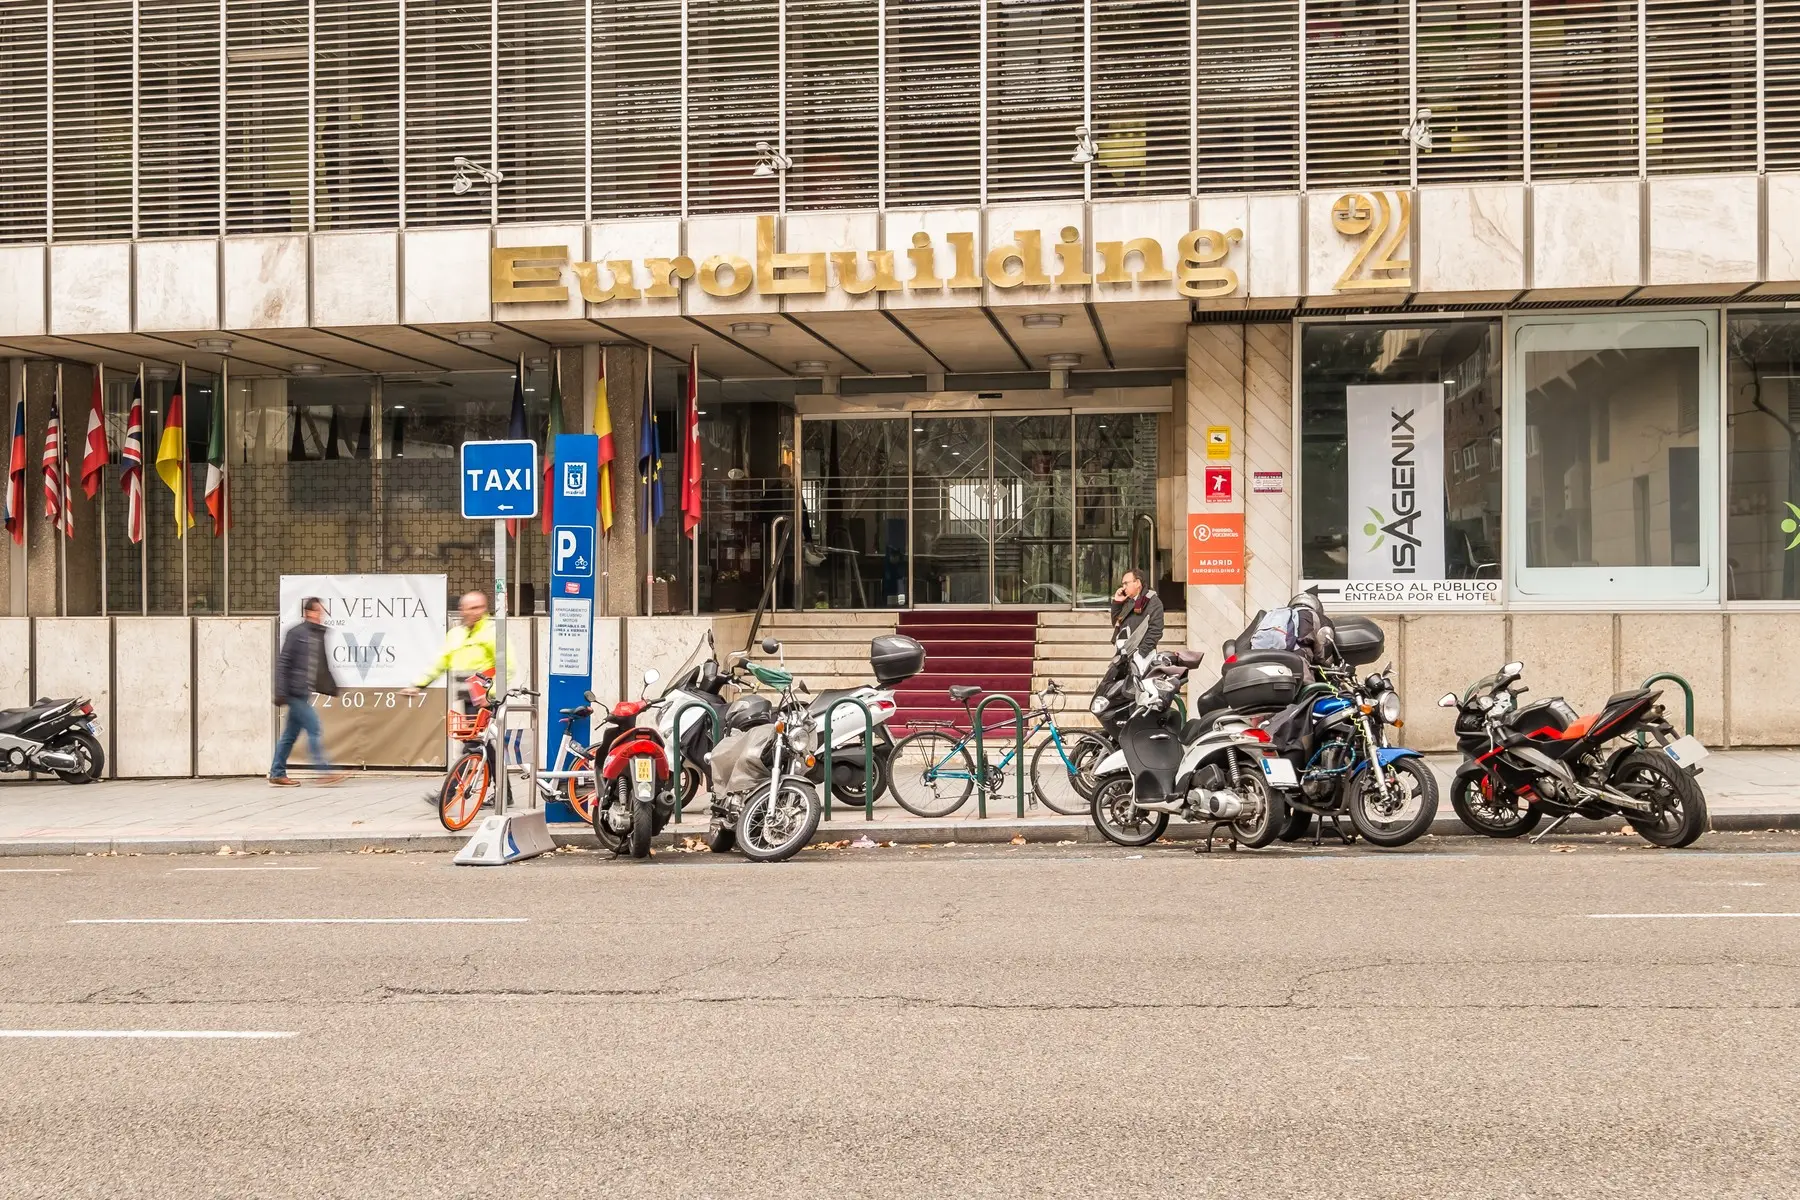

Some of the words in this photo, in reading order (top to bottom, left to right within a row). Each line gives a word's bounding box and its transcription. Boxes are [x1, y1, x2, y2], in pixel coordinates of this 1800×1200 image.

[492, 215, 1243, 303] Eurobuilding
[467, 468, 531, 491] TAXI
[1380, 408, 1422, 574] ISAGENIX
[557, 530, 577, 571] P
[1345, 582, 1404, 592] ACCESO
[1409, 582, 1428, 592] AL
[1433, 580, 1498, 592] PÚBLICO
[1345, 592, 1403, 601] ENTRADA
[1408, 592, 1433, 601] POR
[1438, 592, 1452, 601] EL
[1456, 592, 1497, 601] HOTEL
[342, 597, 429, 618] VENTA
[342, 691, 364, 708] 60
[373, 691, 396, 708] 78
